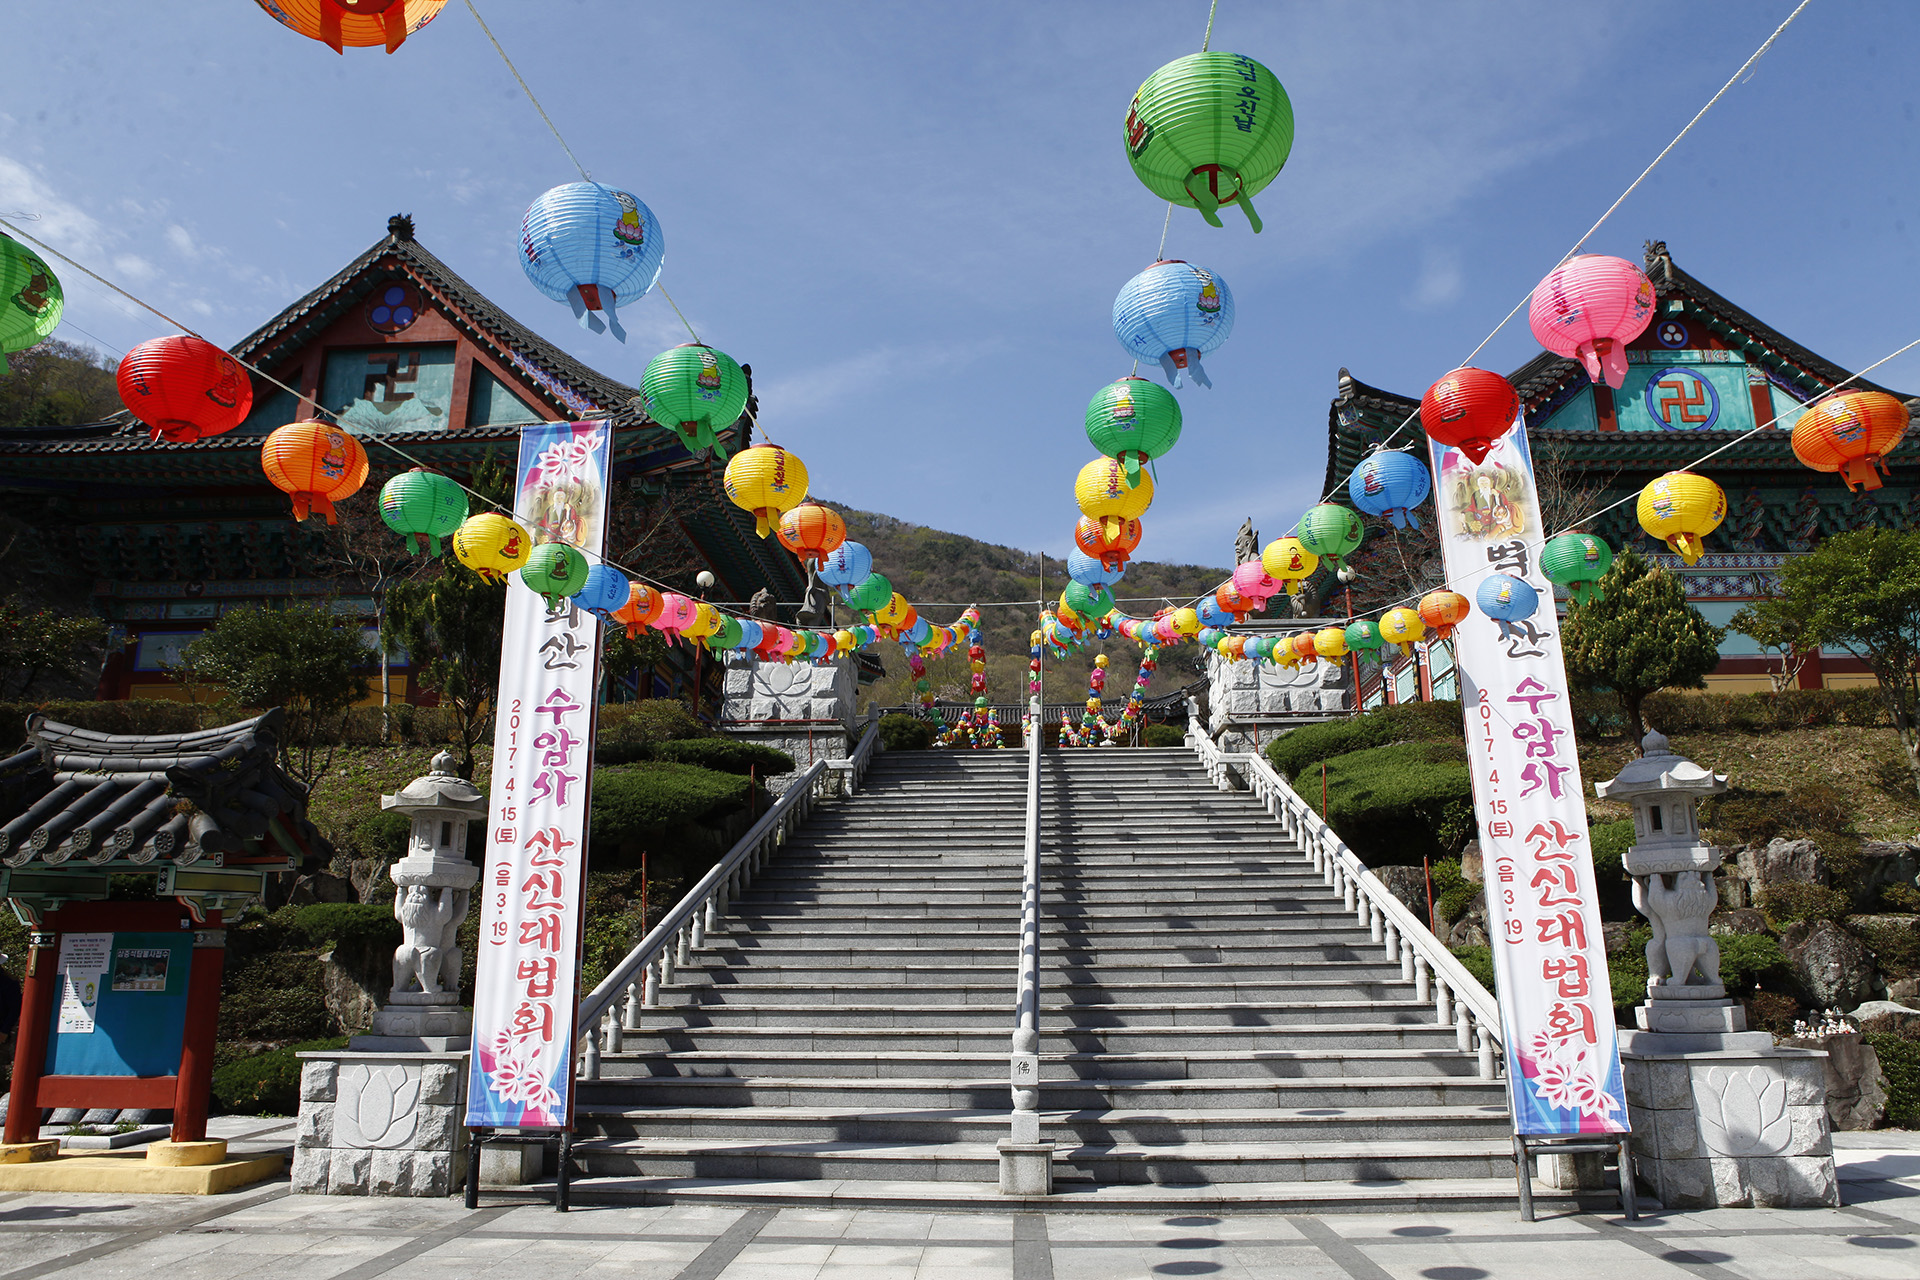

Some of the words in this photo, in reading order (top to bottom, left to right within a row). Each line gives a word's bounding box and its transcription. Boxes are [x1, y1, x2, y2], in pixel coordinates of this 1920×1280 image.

[1232, 86, 1261, 133] 오신날
[1487, 541, 1551, 658] 벽산
[530, 688, 580, 806] 수암사
[1507, 677, 1570, 800] 수암사
[514, 828, 574, 1042] 산신대법회
[1525, 821, 1598, 1045] 산신대법회
